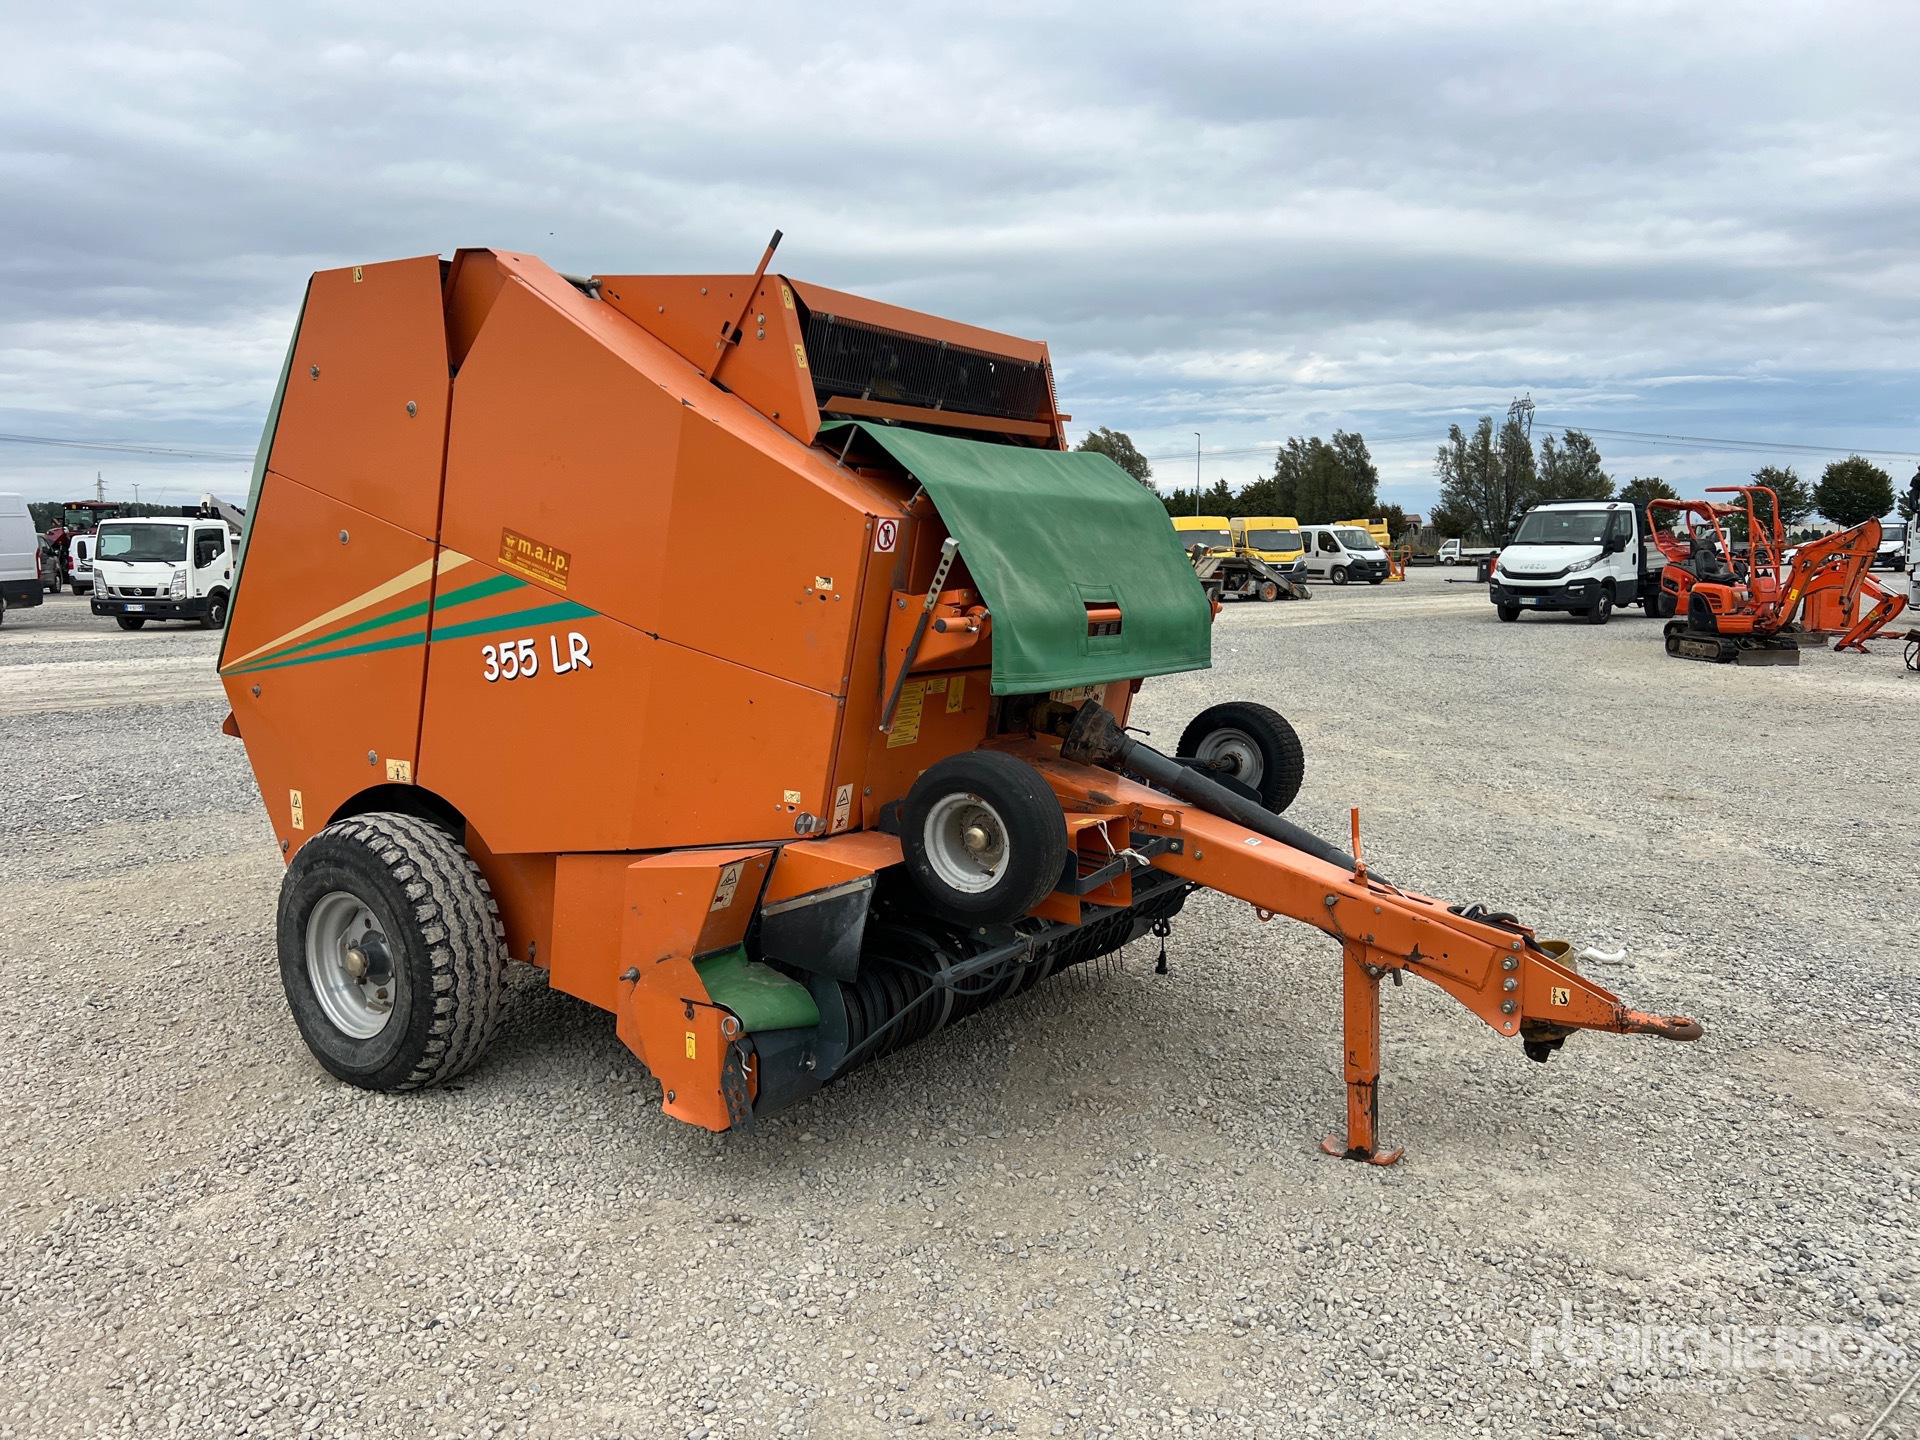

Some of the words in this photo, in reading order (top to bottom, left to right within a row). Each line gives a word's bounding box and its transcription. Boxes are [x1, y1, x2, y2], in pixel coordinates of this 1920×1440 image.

[517, 538, 569, 571] m.a.i.p.
[481, 638, 540, 682] 355
[550, 631, 594, 676] LR
